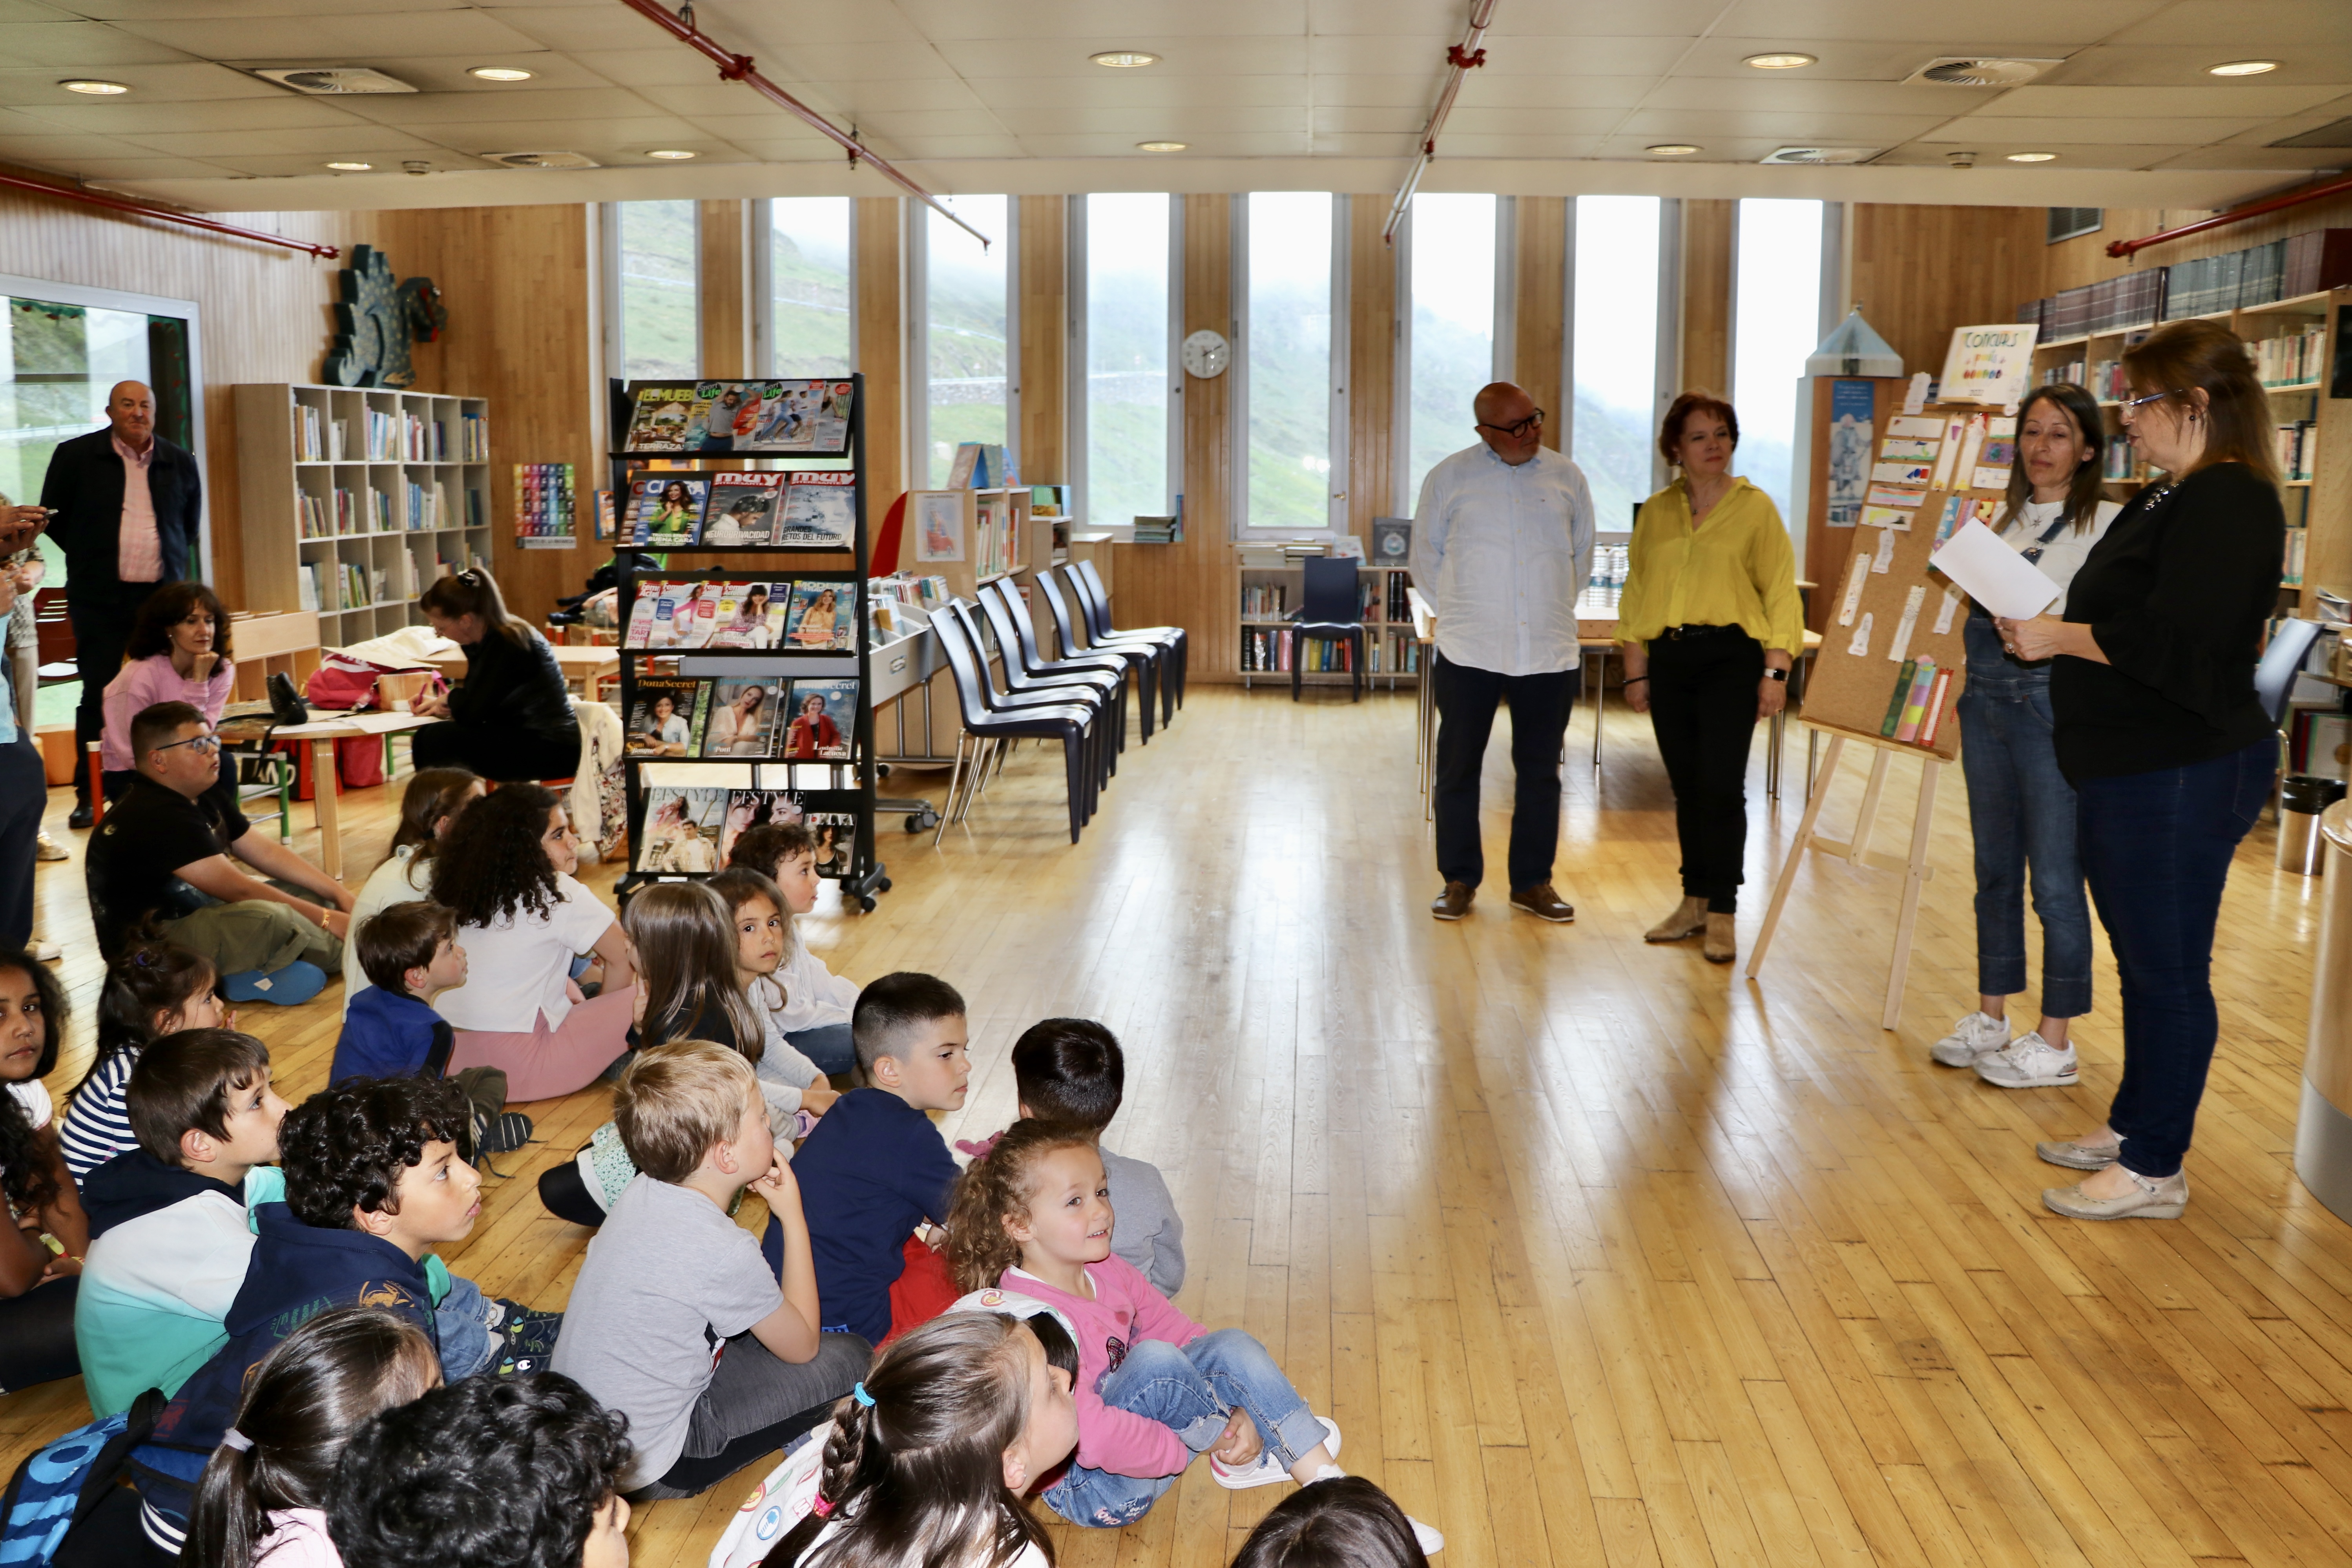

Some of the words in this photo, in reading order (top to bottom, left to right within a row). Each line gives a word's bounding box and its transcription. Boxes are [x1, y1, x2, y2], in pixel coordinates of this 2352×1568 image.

[699, 382, 718, 392] Sport
[765, 382, 779, 391] port
[701, 389, 721, 398] Life
[715, 473, 783, 486] muy
[706, 530, 770, 539] NEUROPRIVACIDAD
[731, 790, 805, 805] EFSTYLE
